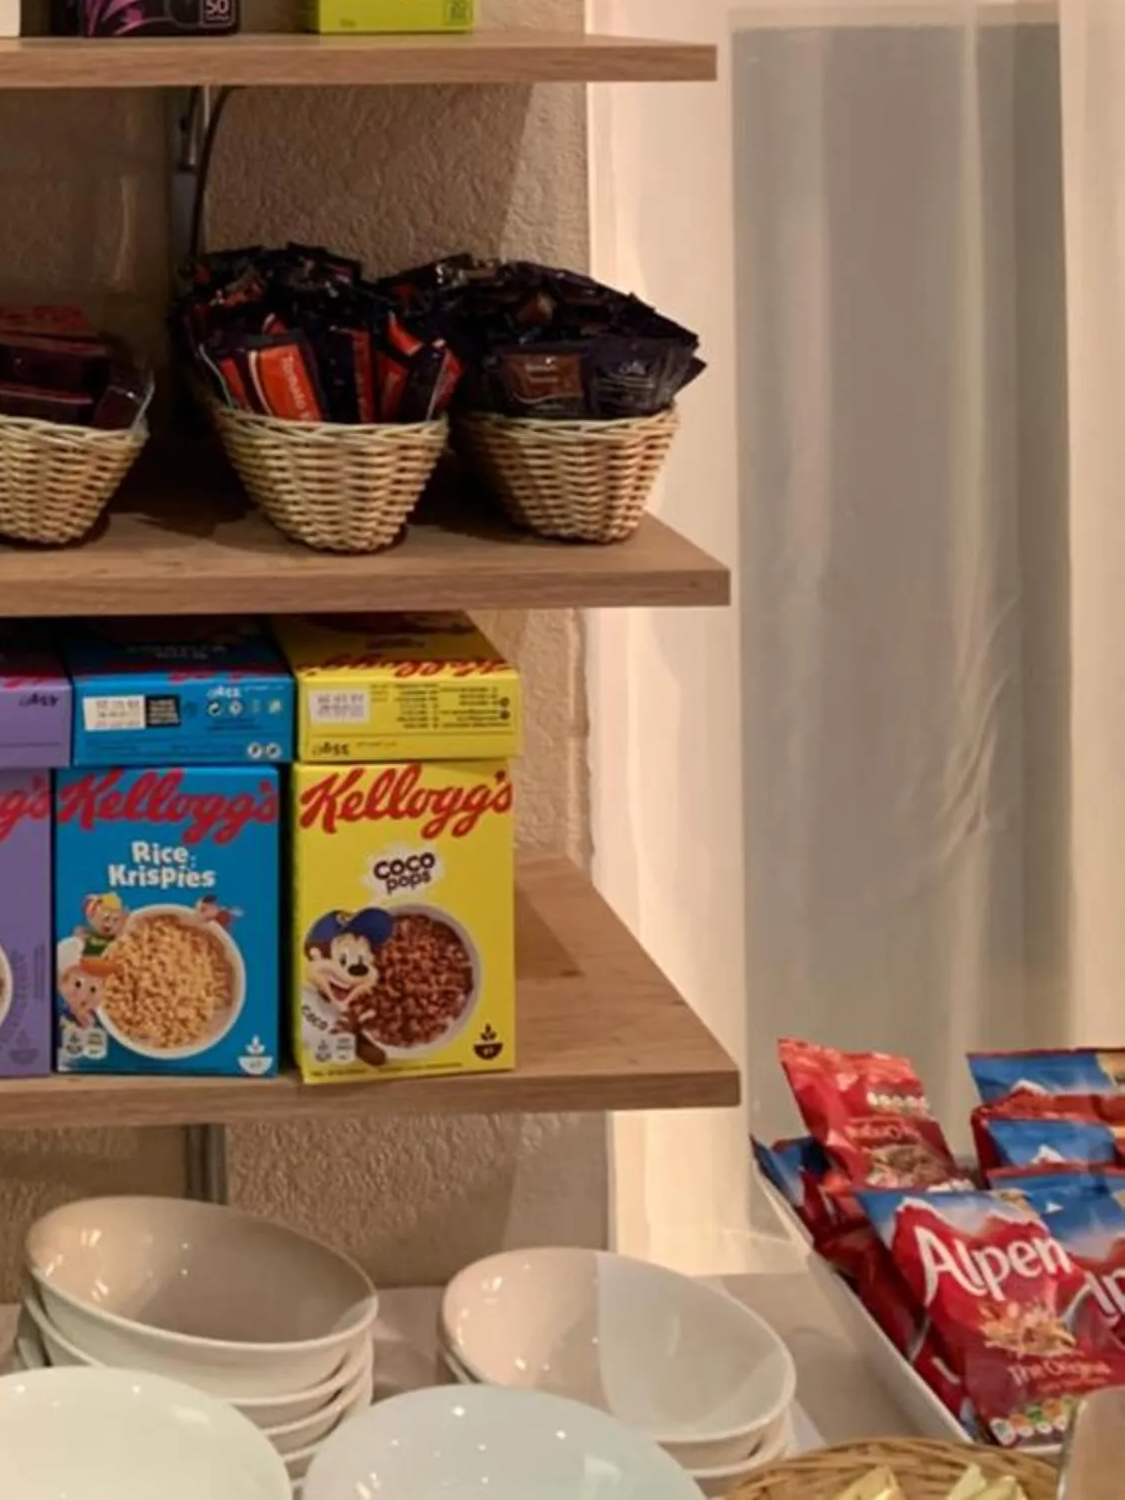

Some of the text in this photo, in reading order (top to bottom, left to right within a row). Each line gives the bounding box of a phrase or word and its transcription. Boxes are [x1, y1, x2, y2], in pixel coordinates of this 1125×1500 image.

[57, 768, 279, 844] Kellogg's
[299, 763, 514, 839] Kellogg's
[108, 864, 216, 889] Krispies
[131, 840, 187, 863] Rice
[385, 869, 432, 895] pops
[913, 1224, 1073, 1307] Alpen
